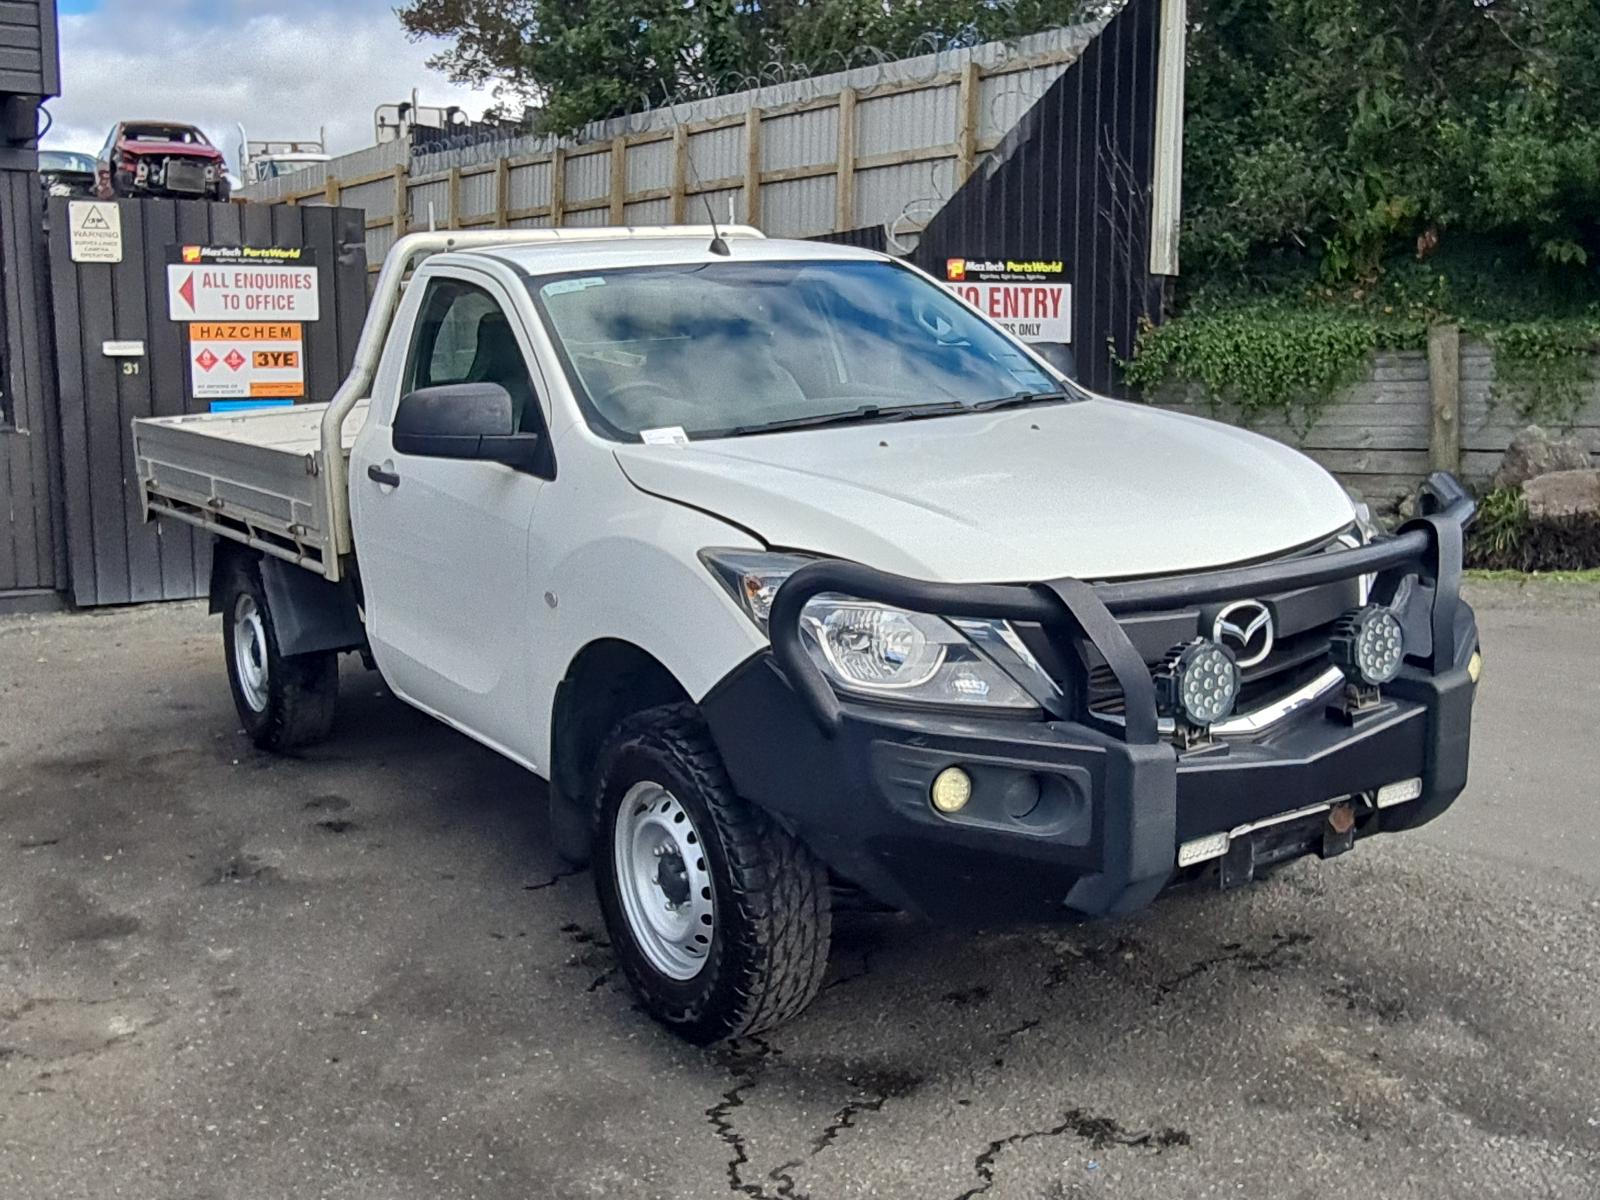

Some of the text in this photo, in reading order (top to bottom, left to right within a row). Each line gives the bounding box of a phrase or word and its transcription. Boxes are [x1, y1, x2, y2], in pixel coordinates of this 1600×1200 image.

[243, 248, 300, 258] PartsWorld
[965, 261, 1063, 273] MaxTech PartsWorld
[202, 272, 312, 290] ALL ENQUIRIES
[222, 294, 295, 311] TO OFFICE
[988, 287, 1063, 319] ENTRY
[200, 326, 292, 339] HAZCHEM
[1018, 323, 1041, 336] ONLY
[257, 351, 295, 367] 3YE
[123, 362, 139, 375] 31
